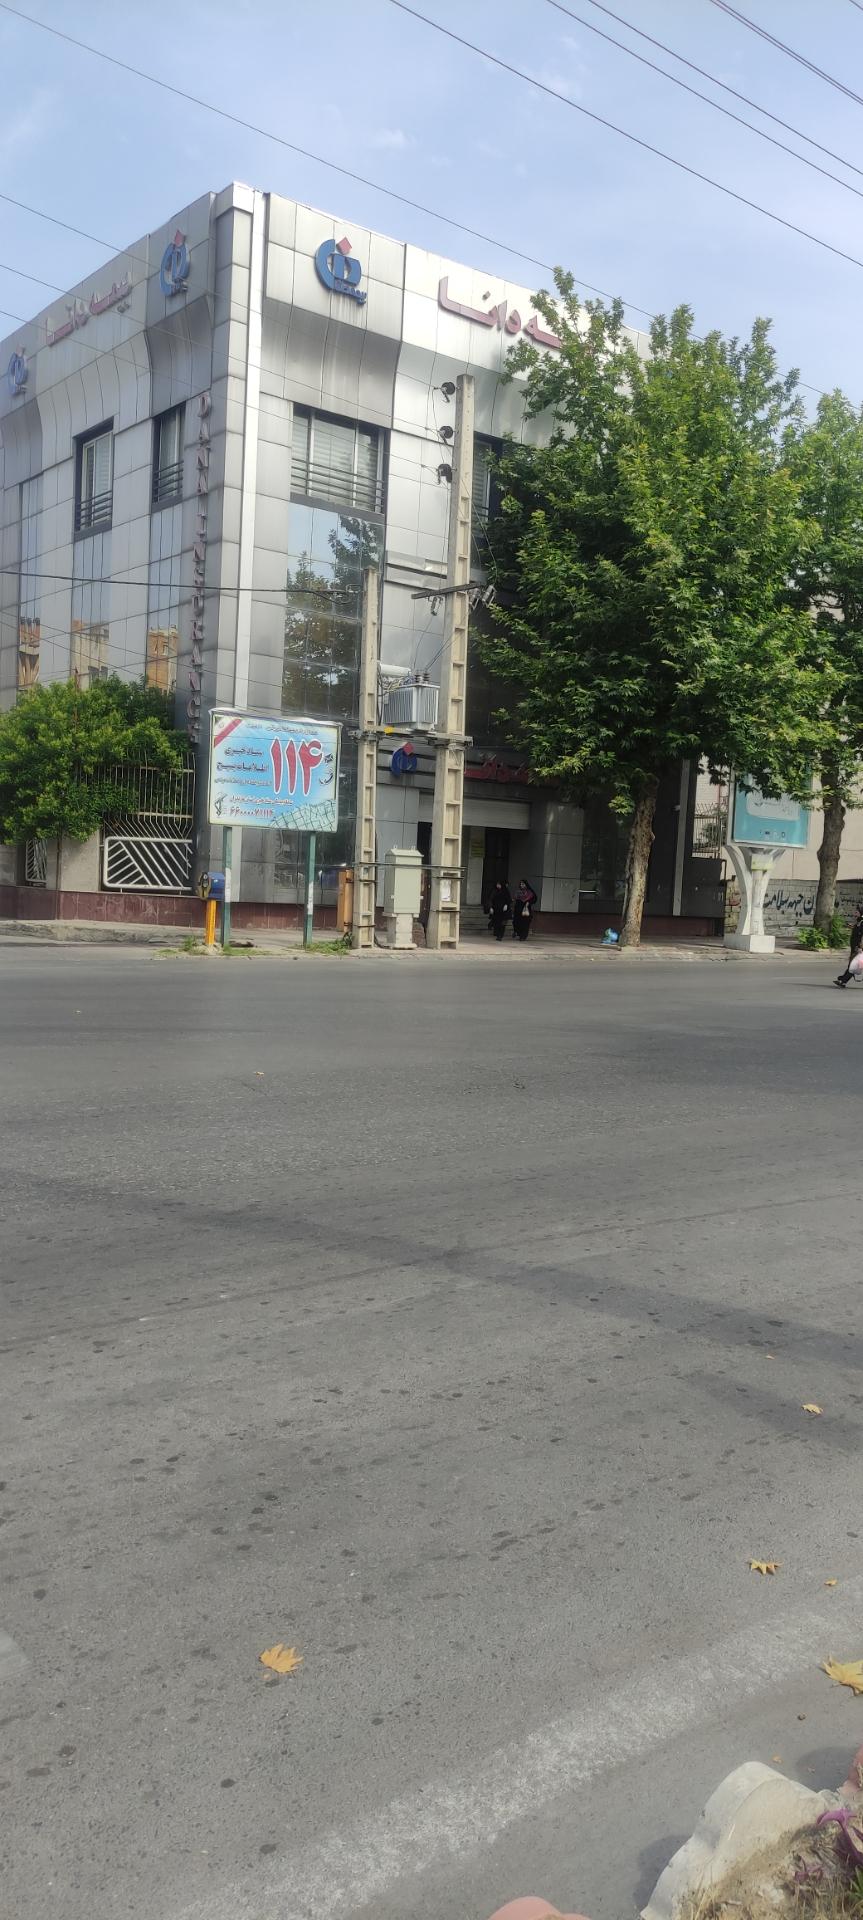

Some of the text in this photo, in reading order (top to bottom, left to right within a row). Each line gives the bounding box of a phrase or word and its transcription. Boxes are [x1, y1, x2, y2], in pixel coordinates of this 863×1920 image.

[46, 297, 90, 348] دانا
[438, 276, 522, 335] دانا
[196, 392, 211, 496] DANA
[271, 737, 322, 796] ۱۱۴
